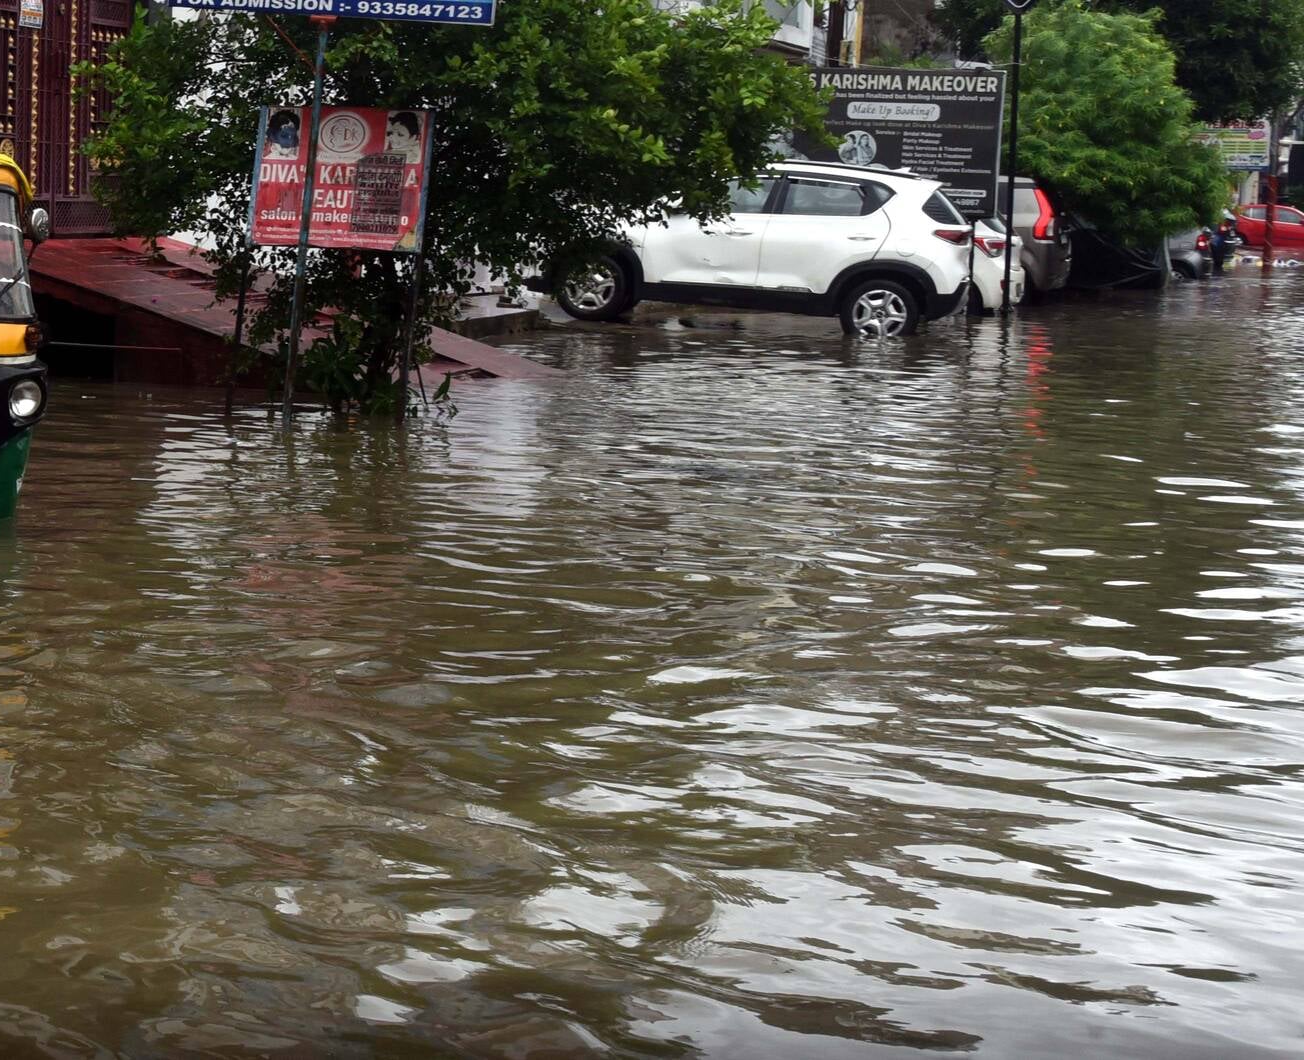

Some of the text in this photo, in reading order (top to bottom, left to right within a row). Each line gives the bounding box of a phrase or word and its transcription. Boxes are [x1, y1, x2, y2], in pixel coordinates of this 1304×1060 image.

[358, 1, 482, 18] 9335847123
[820, 73, 903, 90] KARISHMA
[907, 75, 998, 92] MAKEOVER
[851, 104, 935, 119] Make Up Booking?
[259, 163, 306, 183] DIVA'
[319, 165, 418, 188] KARA
[302, 188, 370, 209] EAUT
[261, 206, 296, 221] salon
[312, 209, 360, 225] make
